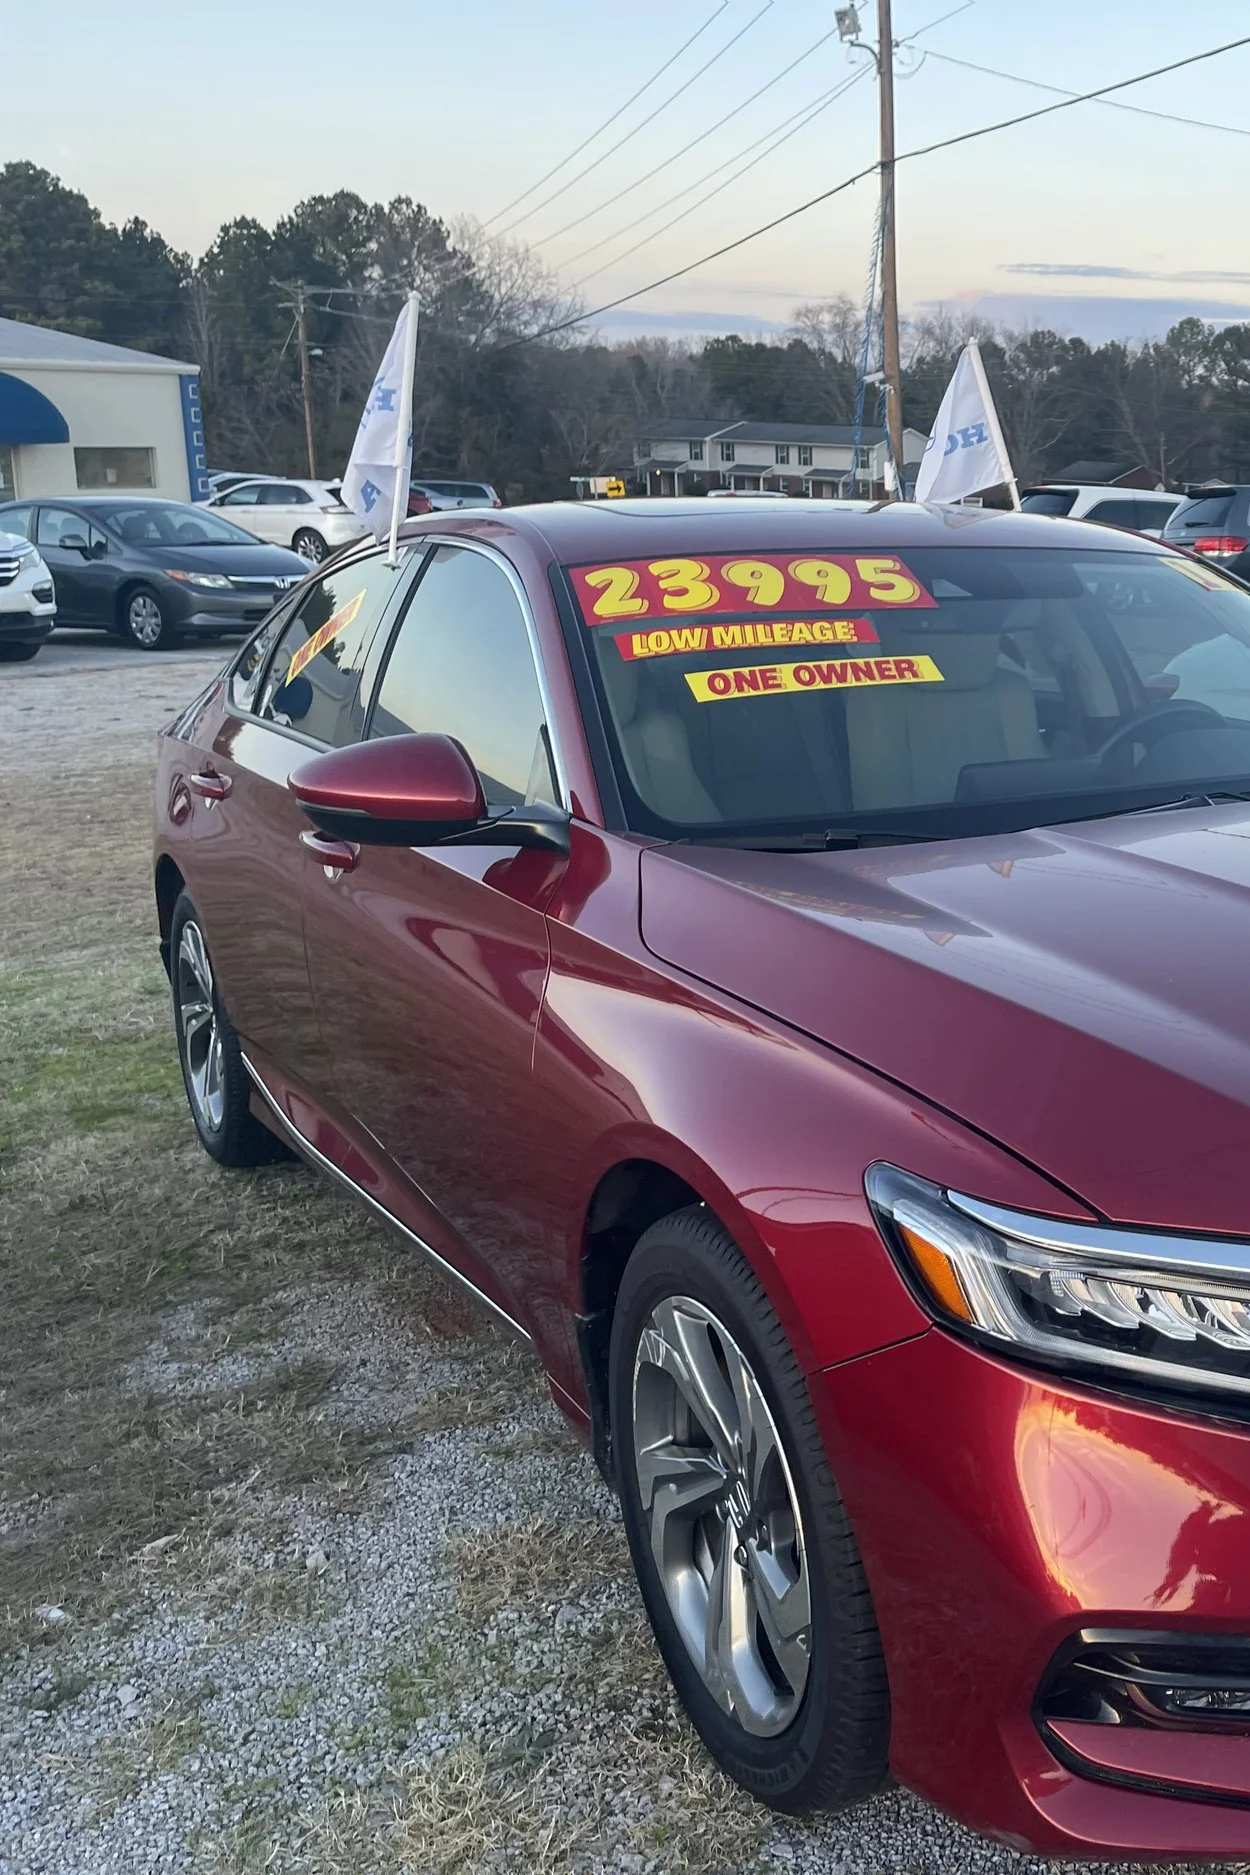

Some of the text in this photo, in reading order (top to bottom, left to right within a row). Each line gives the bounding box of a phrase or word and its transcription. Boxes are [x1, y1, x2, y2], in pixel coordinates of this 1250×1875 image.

[584, 559, 921, 617] 23995
[631, 621, 858, 658] LOW MILEAGE
[707, 658, 925, 696] ONE OWNER
